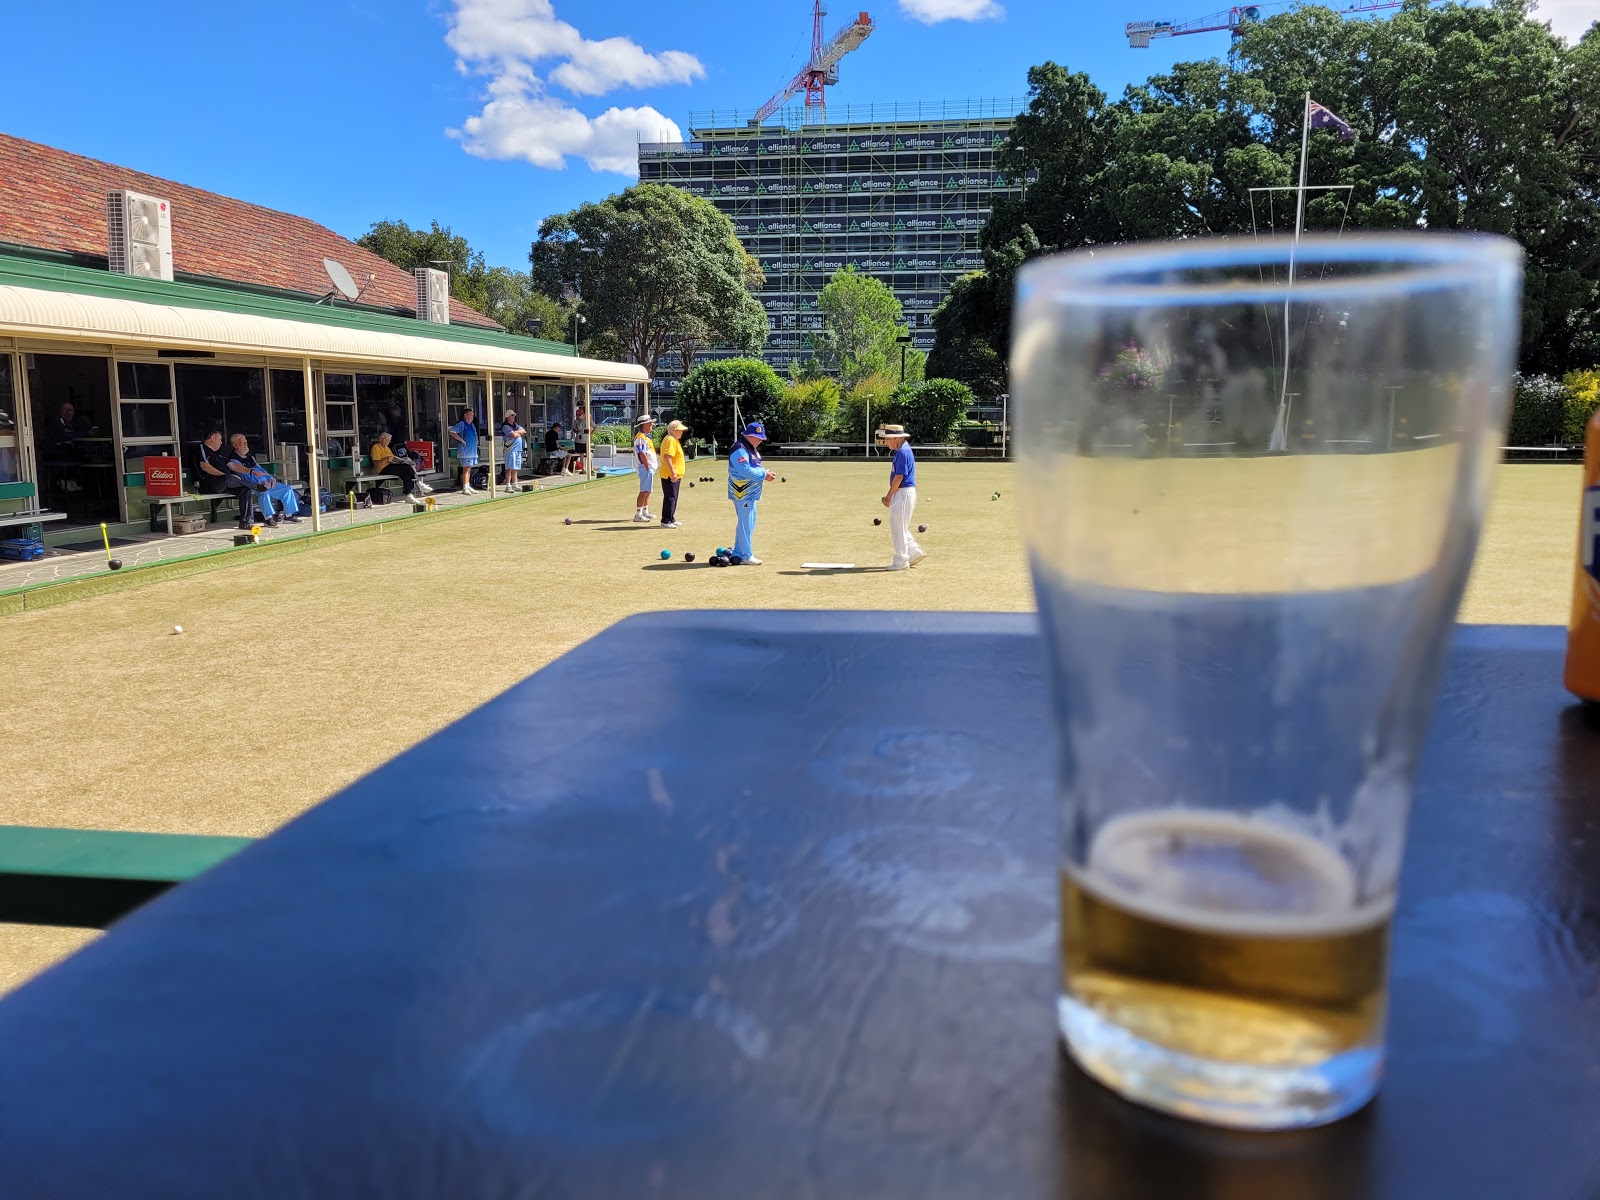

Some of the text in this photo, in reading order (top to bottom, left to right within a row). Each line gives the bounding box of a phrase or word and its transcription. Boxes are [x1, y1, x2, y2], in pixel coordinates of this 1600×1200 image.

[860, 140, 890, 148] alliance
[905, 138, 935, 146] alliance
[955, 137, 985, 145] alliance
[721, 144, 749, 152] alliance
[768, 143, 796, 151] alliance
[812, 142, 841, 150] alliance
[814, 182, 843, 190] alliance
[862, 180, 891, 188] alliance
[908, 179, 938, 187] alliance
[721, 184, 750, 192] alliance
[860, 220, 890, 228] alliance
[906, 219, 936, 227] alliance
[956, 218, 986, 226] alliance
[772, 261, 800, 269] alliance
[956, 257, 985, 265] alliance
[766, 300, 794, 308] alliance
[772, 338, 800, 346] alliance
[151, 470, 174, 479] Elders
